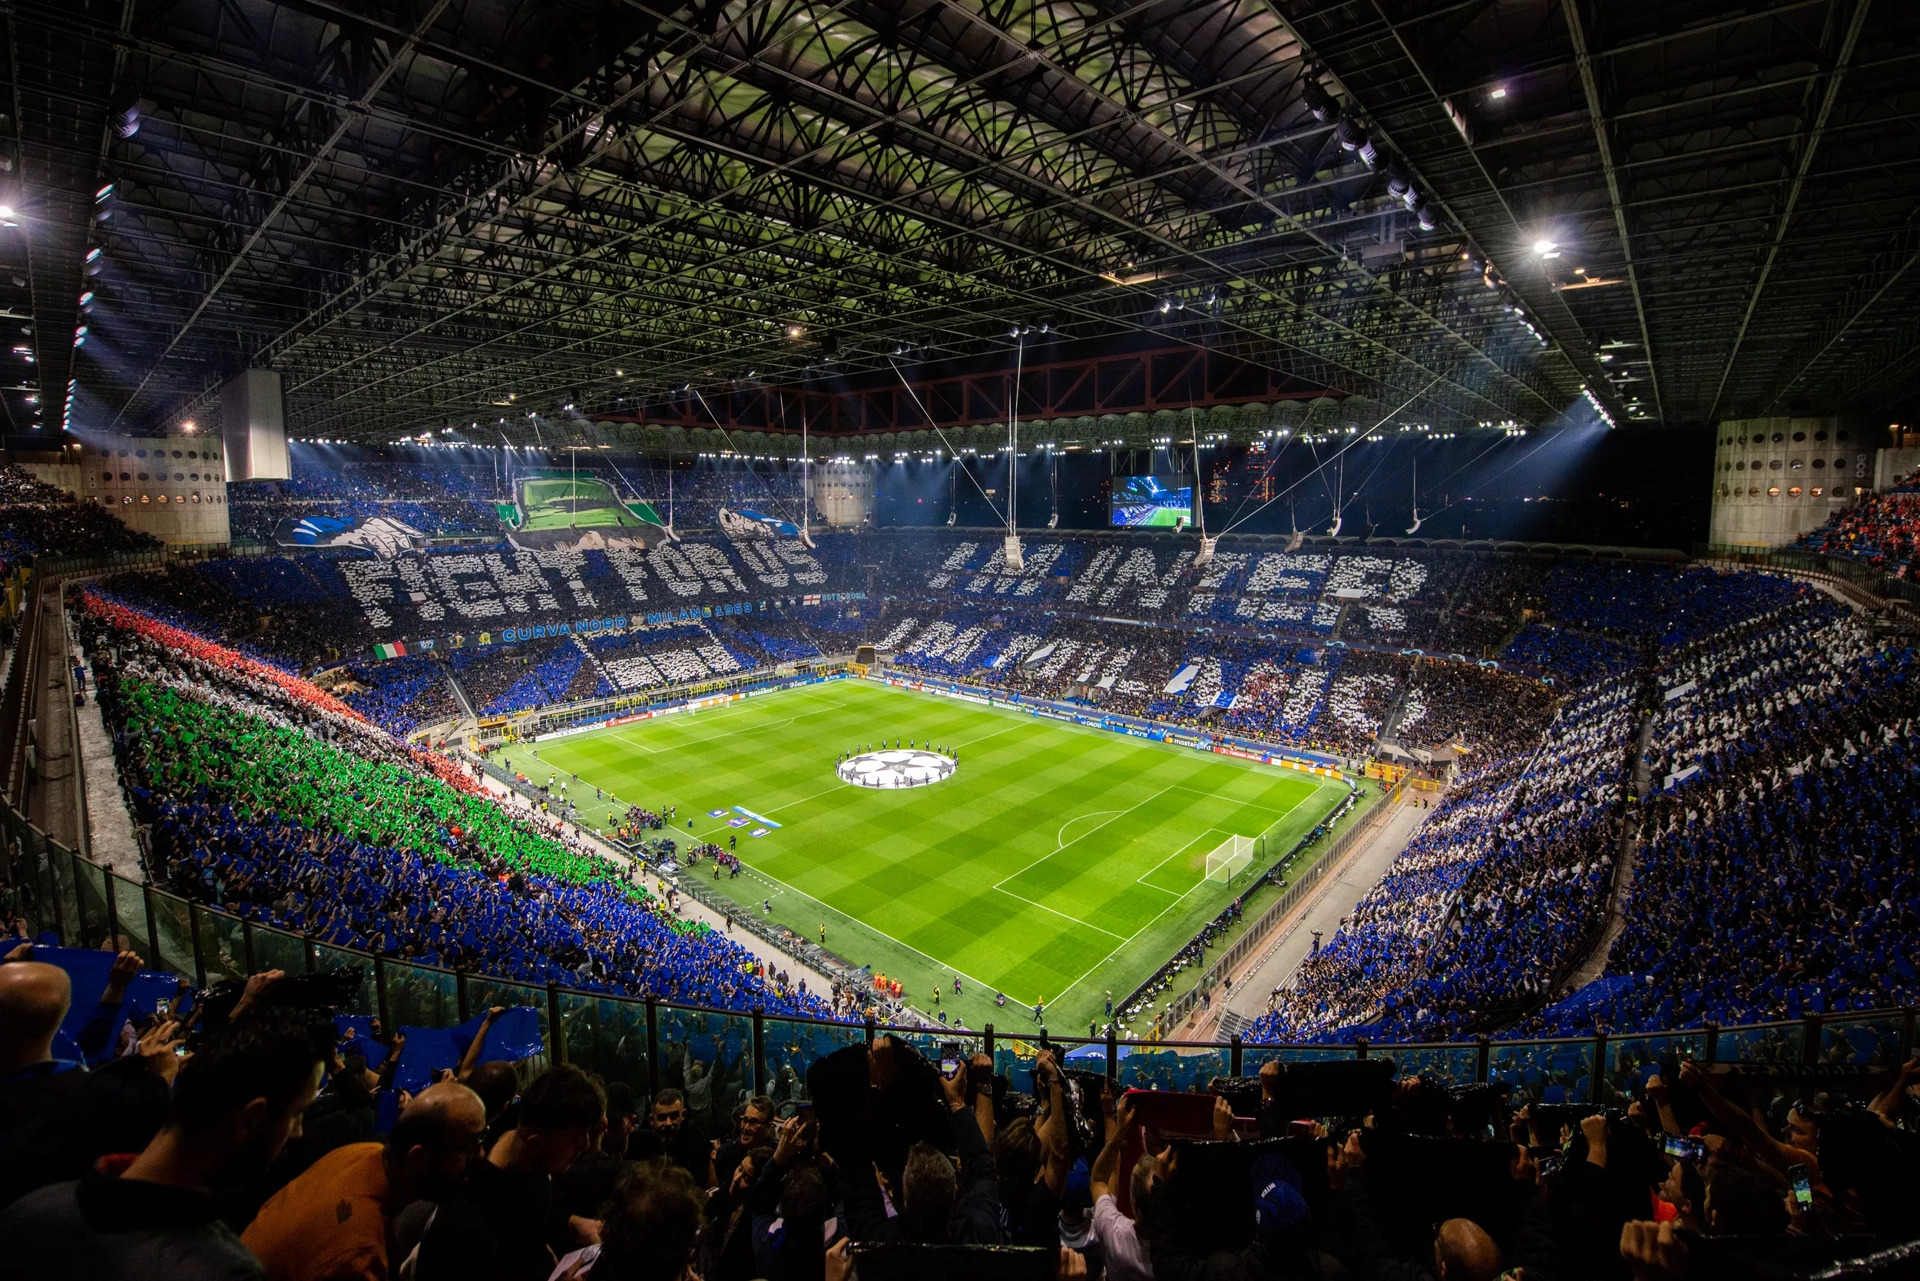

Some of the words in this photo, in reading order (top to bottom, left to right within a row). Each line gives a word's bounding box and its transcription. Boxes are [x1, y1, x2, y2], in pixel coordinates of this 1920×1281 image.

[338, 549, 599, 629] FIGHT
[603, 542, 749, 601] FOR
[731, 538, 828, 588] US
[502, 621, 571, 643] CURVA
[575, 616, 628, 634] NORD
[647, 605, 712, 625] MILANO
[715, 602, 753, 618] 1969
[1174, 739, 1211, 750] masterrd
